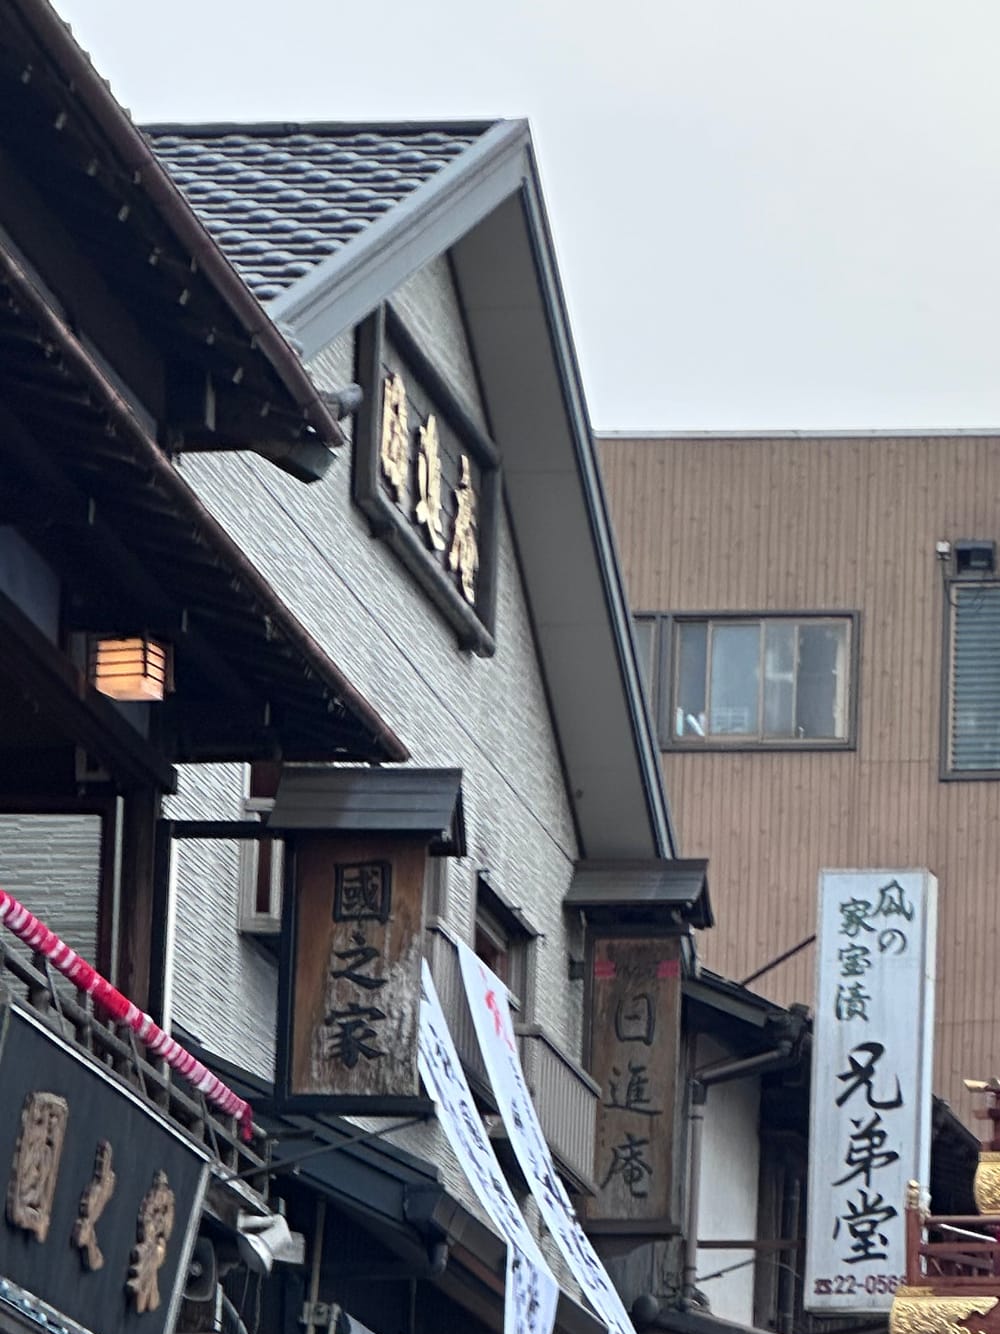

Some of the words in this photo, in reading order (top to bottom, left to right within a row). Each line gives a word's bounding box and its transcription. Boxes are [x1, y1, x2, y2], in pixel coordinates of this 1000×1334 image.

[325, 858, 391, 1067] 國之家
[832, 1042, 903, 1264] 兄弟堂
